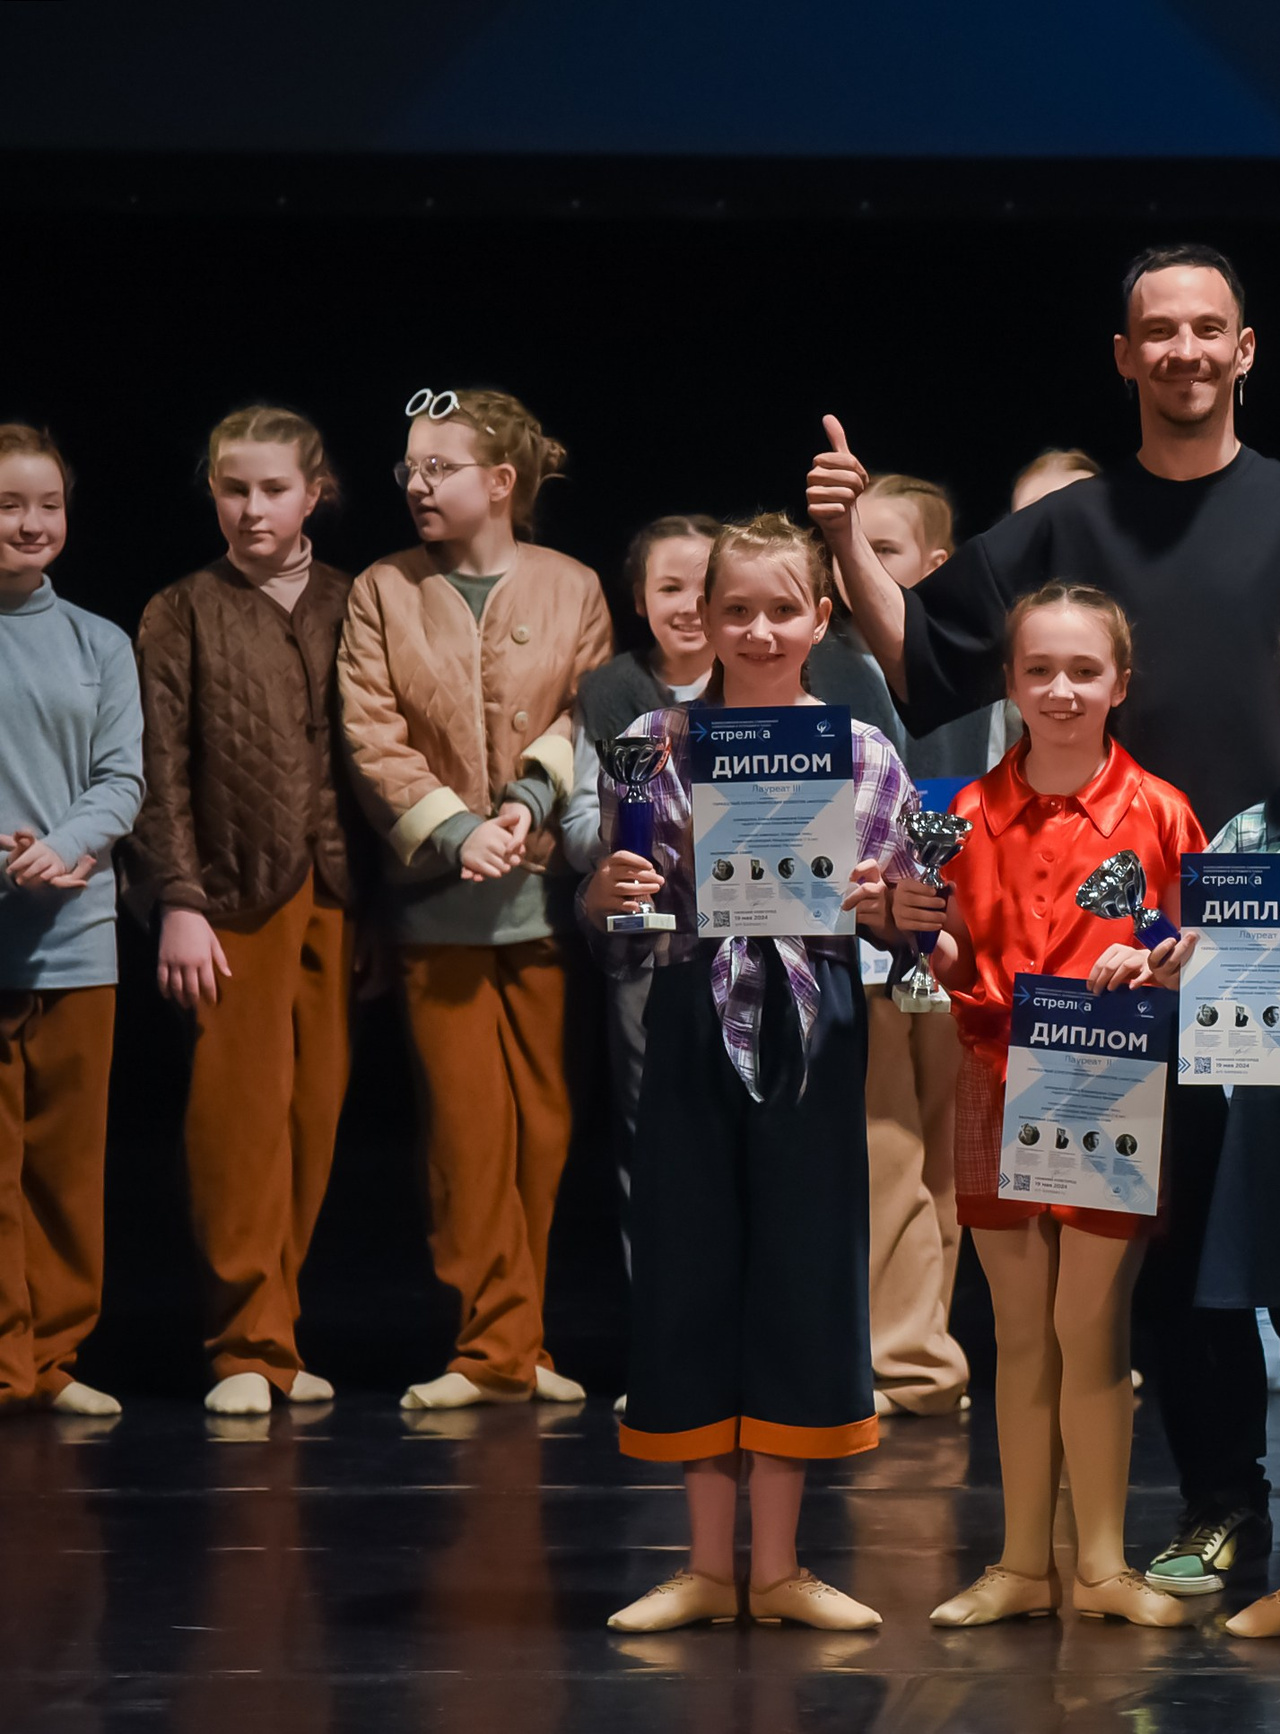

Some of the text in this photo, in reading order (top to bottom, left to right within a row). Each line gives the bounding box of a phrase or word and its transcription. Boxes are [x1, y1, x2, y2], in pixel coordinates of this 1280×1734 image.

[712, 753, 832, 779] ДИПЛОМ
[752, 784, 790, 795] Лауреат
[1239, 930, 1277, 941] Лауреат
[1030, 1022, 1148, 1053] ДИПЛОМ
[1064, 1055, 1102, 1067] Лауреат
